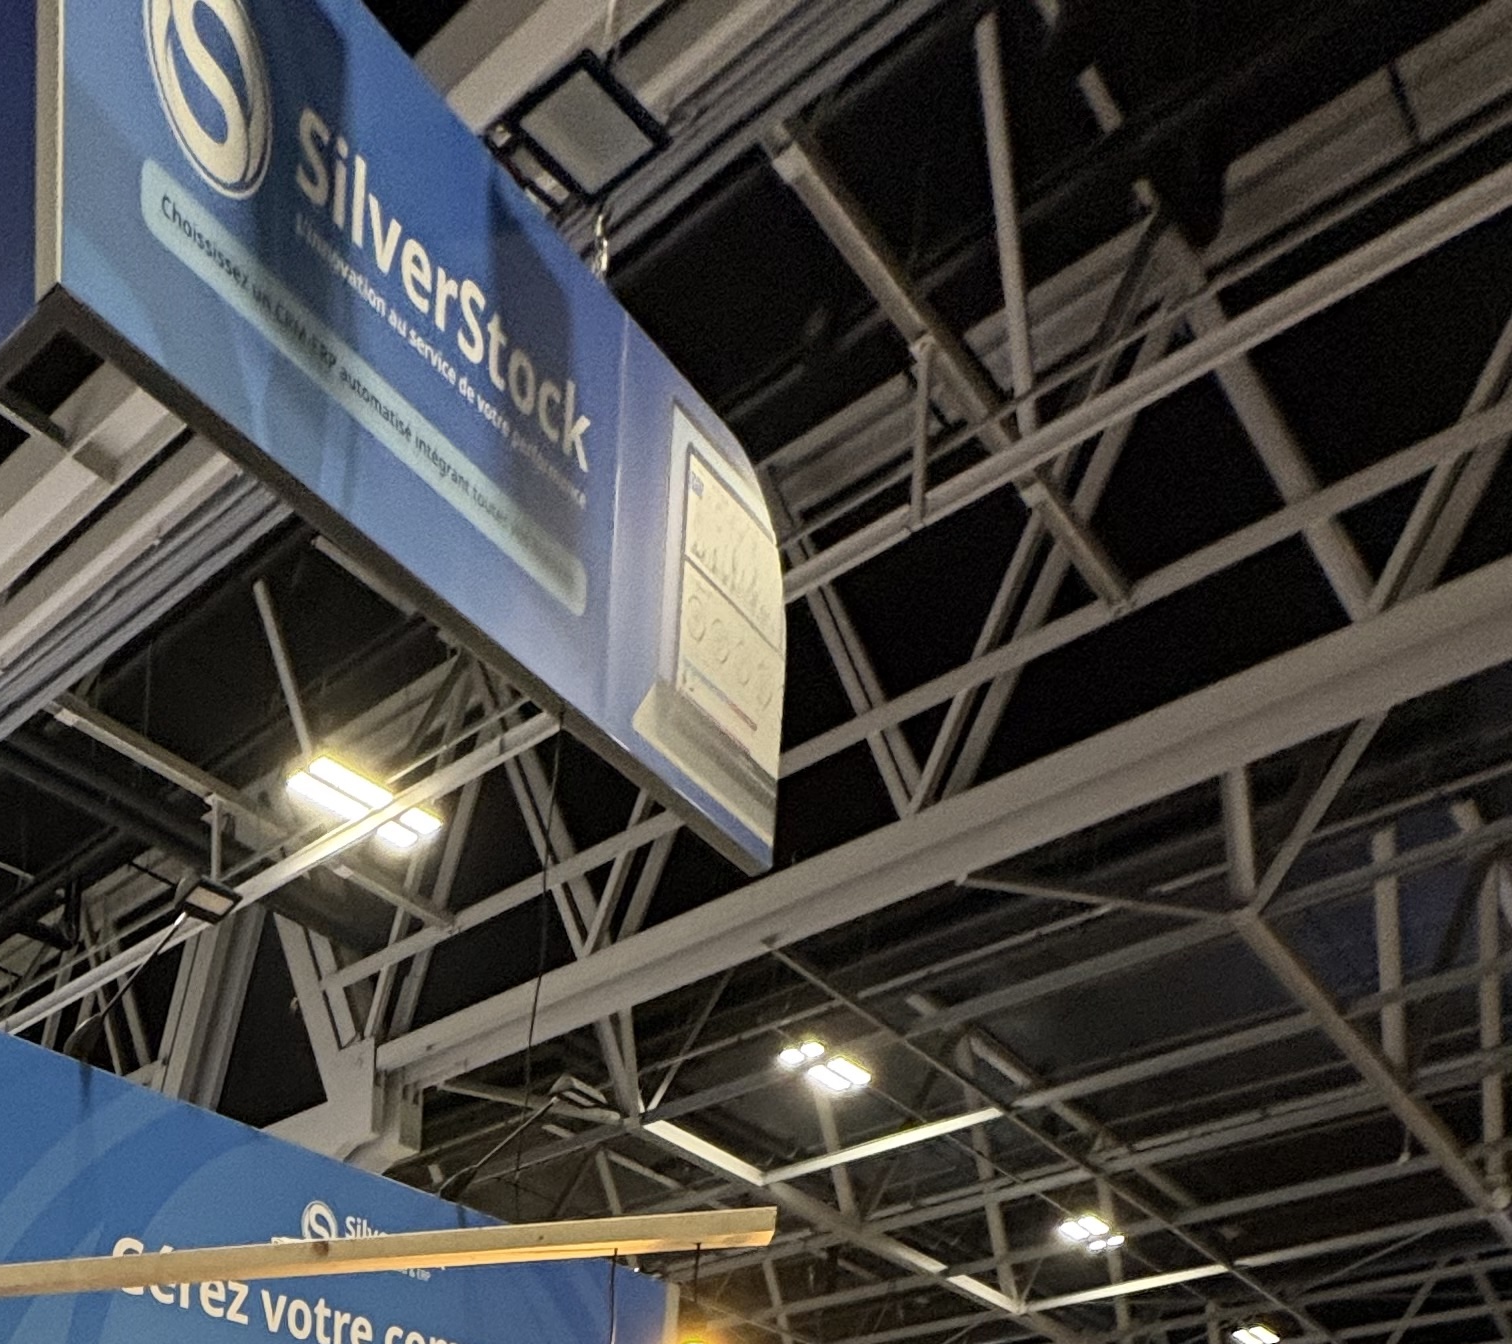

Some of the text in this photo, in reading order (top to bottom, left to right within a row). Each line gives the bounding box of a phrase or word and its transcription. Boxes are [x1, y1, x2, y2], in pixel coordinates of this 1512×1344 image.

[296, 107, 590, 473] SilverStock
[340, 367, 413, 443] automatisé
[414, 435, 470, 495] intégrant
[388, 307, 407, 340] au
[409, 330, 456, 386] service
[458, 376, 475, 403] de
[476, 393, 510, 437] votre
